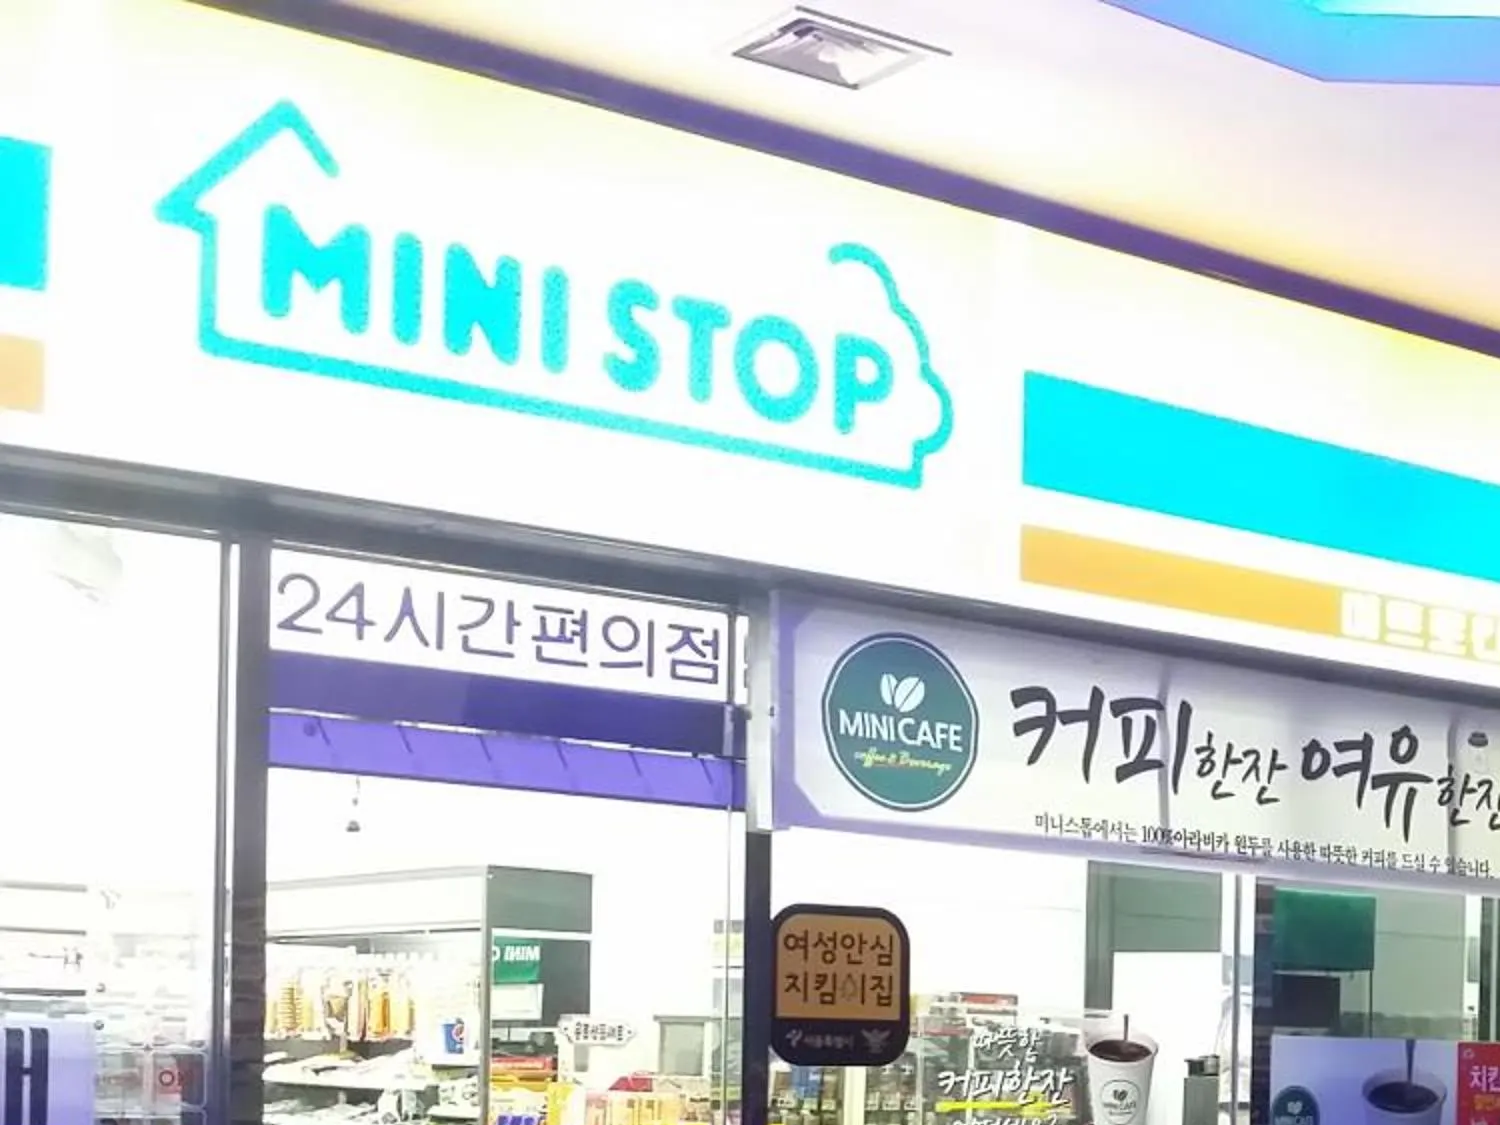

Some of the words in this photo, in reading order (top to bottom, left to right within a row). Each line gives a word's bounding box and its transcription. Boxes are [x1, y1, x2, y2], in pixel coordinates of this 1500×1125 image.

[276, 572, 721, 685] 24시간편의점
[1277, 838, 1317, 862] 사용한
[783, 929, 894, 967] 여성안심
